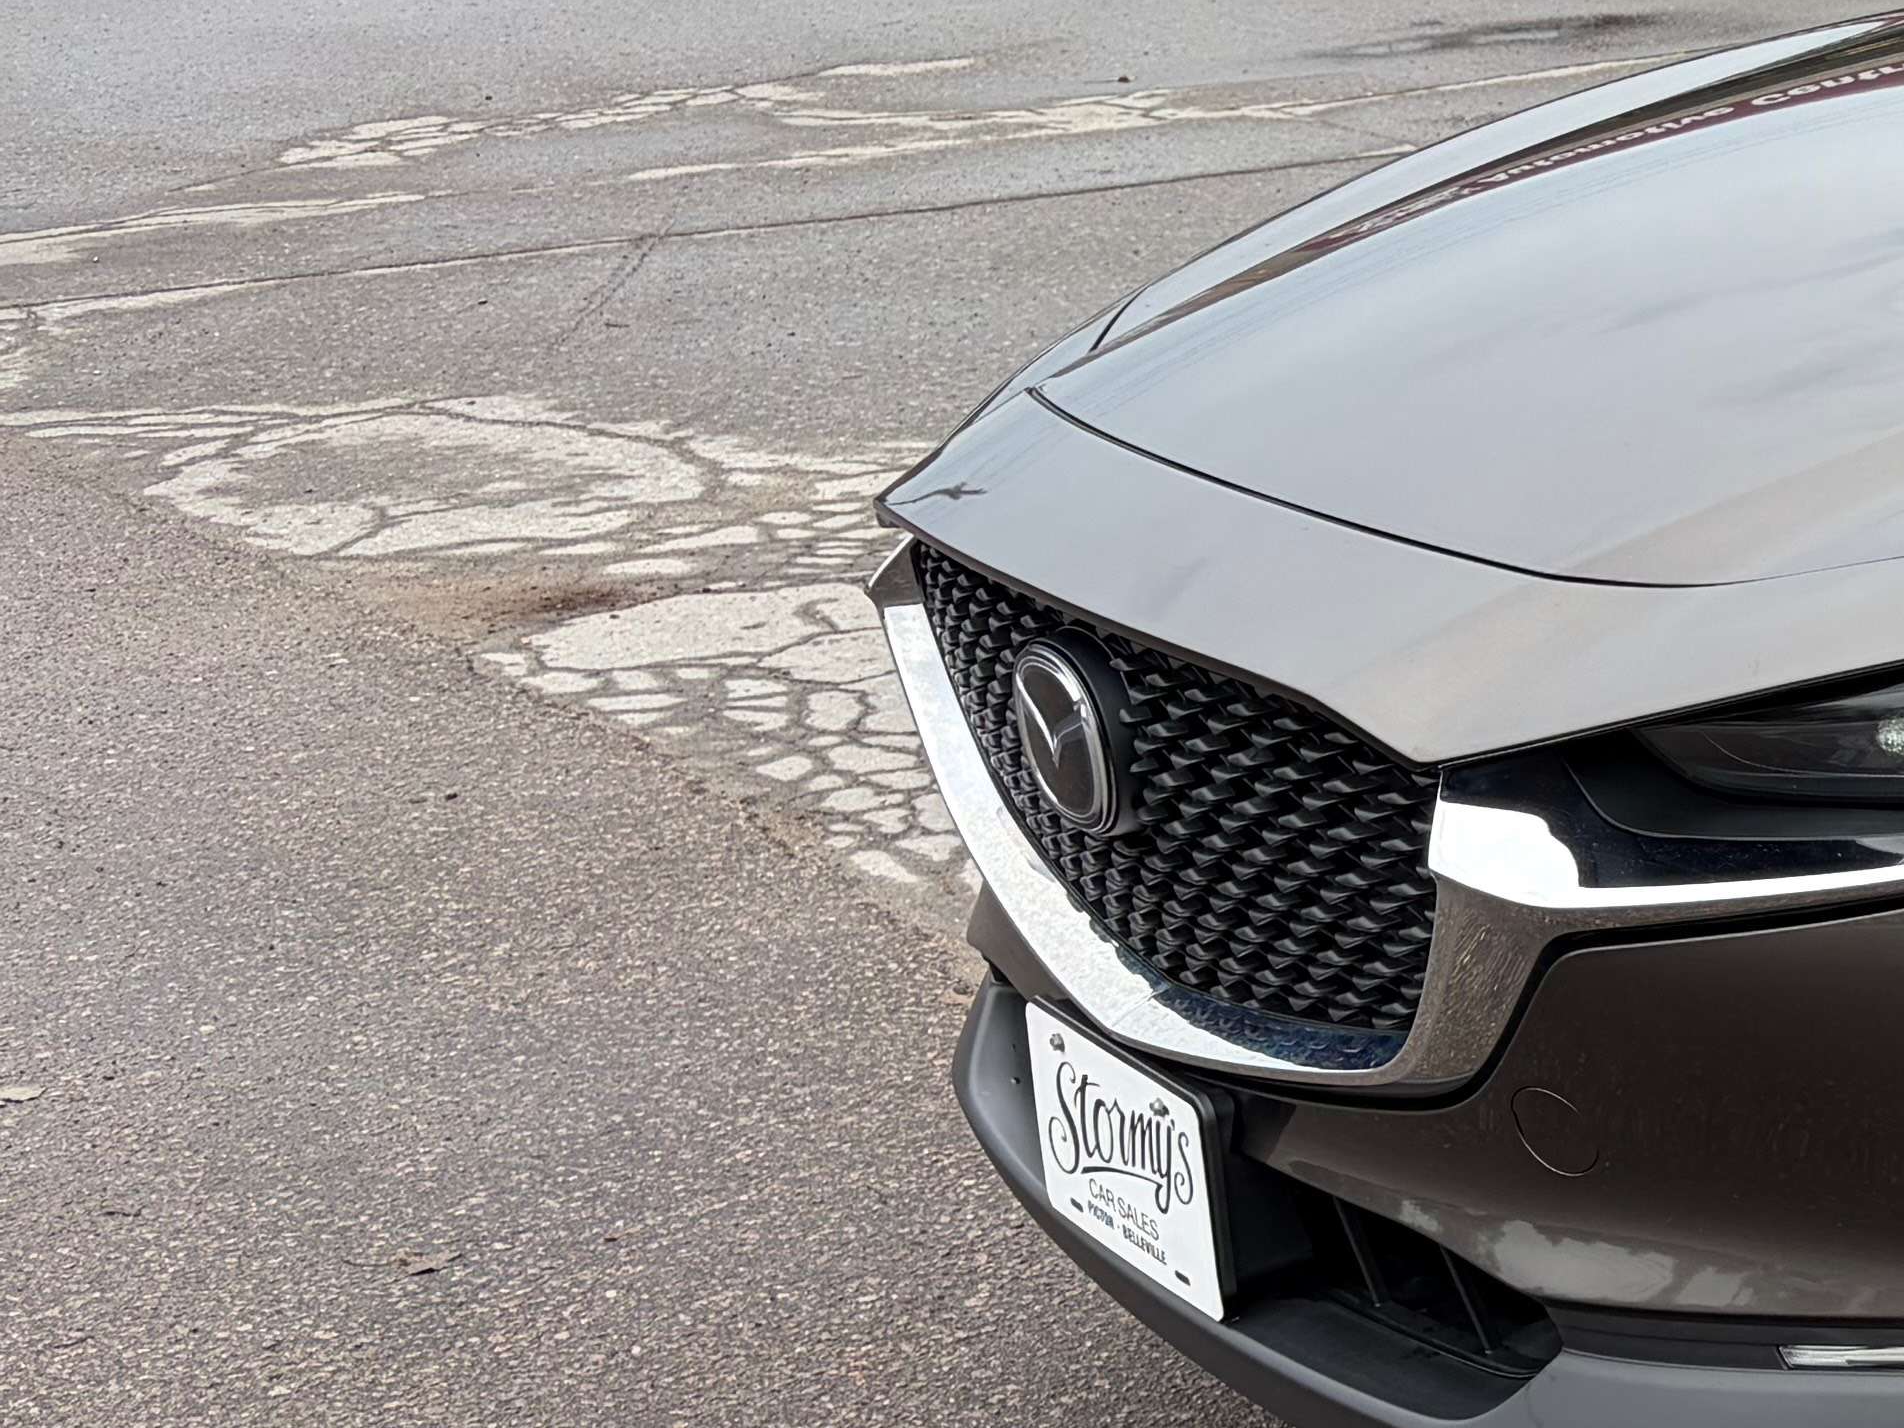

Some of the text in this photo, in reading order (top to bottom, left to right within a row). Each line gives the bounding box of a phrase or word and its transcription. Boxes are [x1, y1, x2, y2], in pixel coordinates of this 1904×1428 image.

[1048, 1061, 1193, 1214] Stormy's
[1089, 1178, 1159, 1241] CAR SALES
